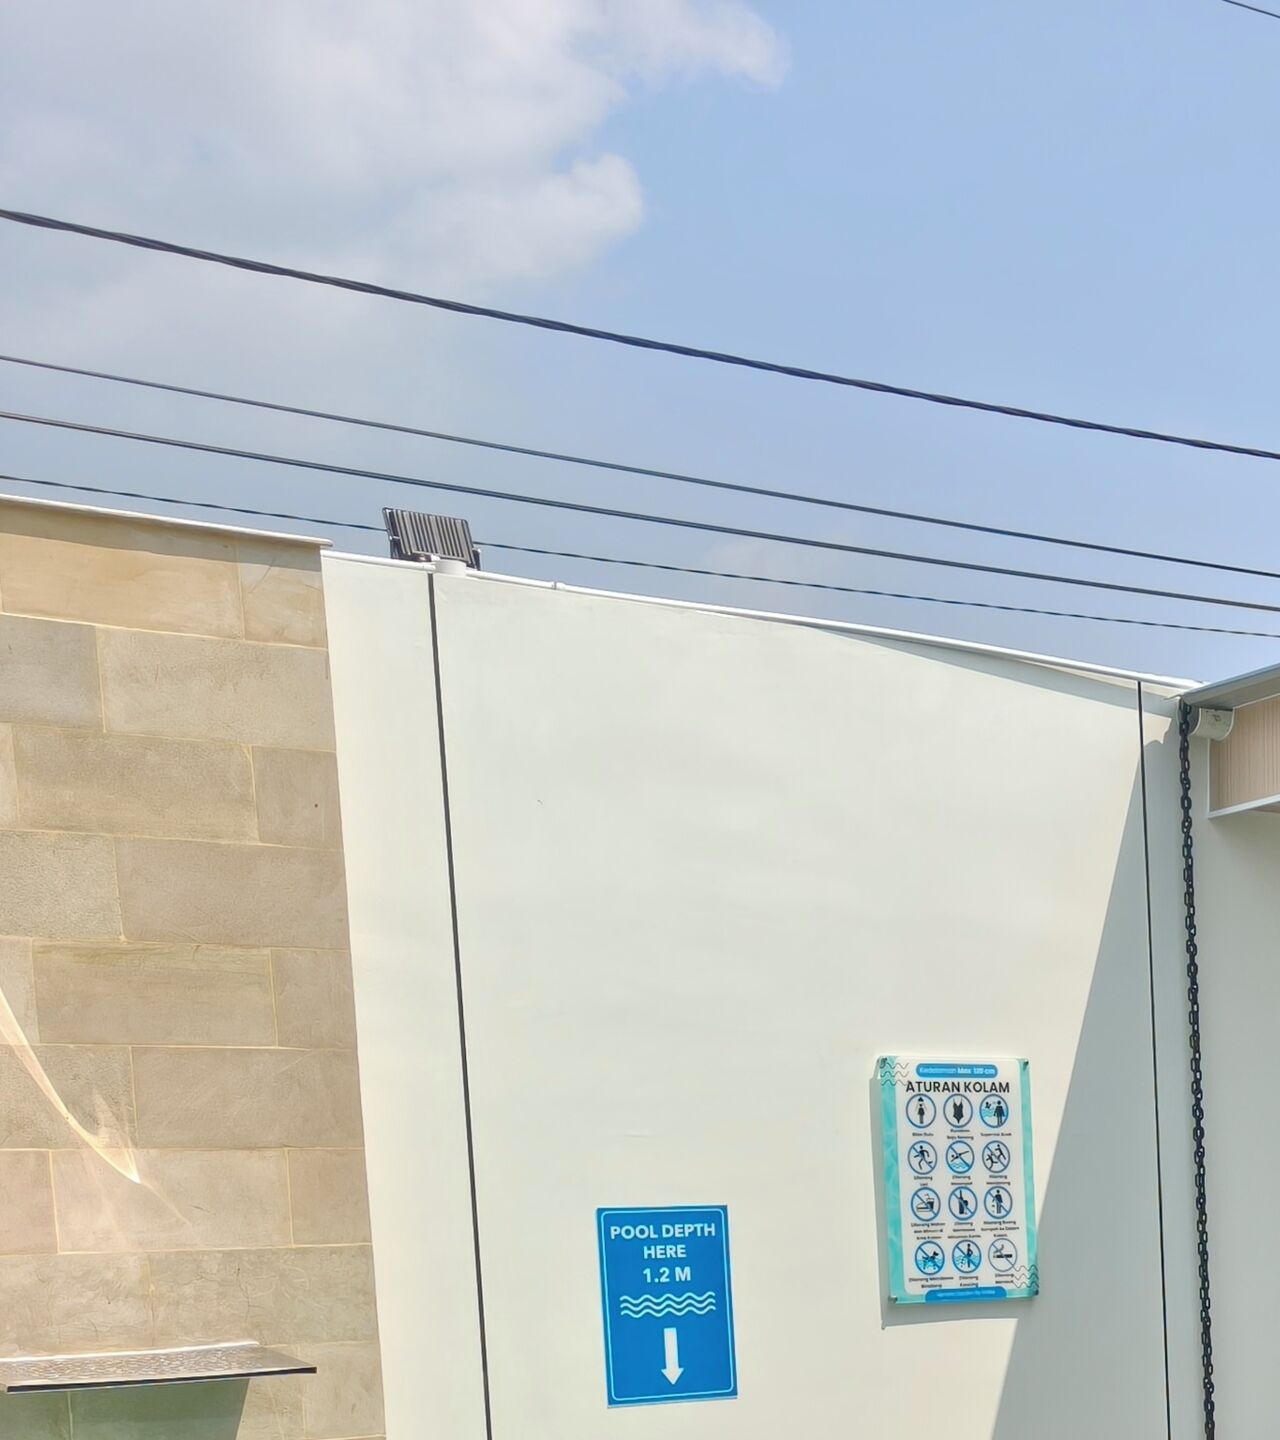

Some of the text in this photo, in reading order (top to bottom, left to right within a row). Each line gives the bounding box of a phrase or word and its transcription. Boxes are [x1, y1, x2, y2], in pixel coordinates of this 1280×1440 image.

[905, 1081, 1010, 1093] ATURAN KOLAM
[610, 1223, 716, 1240] POOL DEPTH
[643, 1244, 687, 1259] HERE
[643, 1266, 691, 1283] 1.2 M
